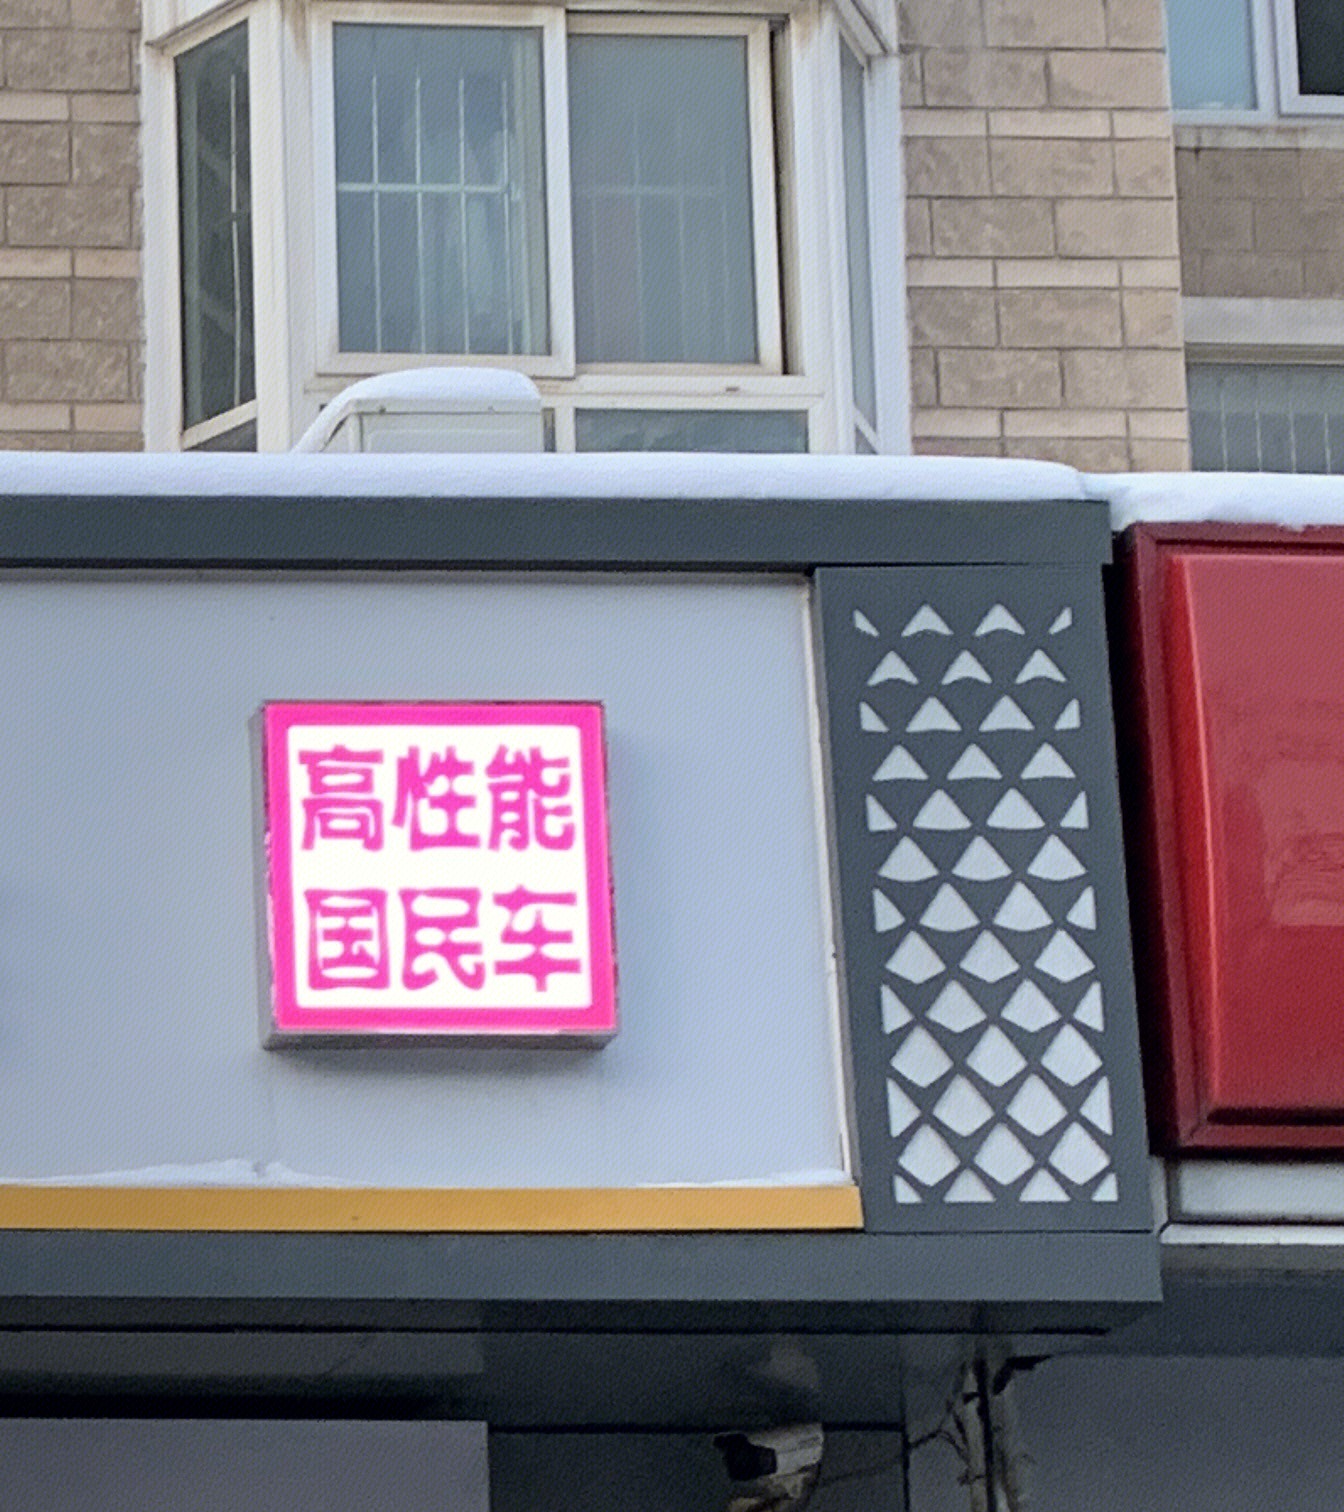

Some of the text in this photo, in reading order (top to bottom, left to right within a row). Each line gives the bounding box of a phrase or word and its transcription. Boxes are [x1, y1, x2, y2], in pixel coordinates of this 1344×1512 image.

[295, 743, 576, 852] 高性能
[303, 885, 583, 993] 国民车
